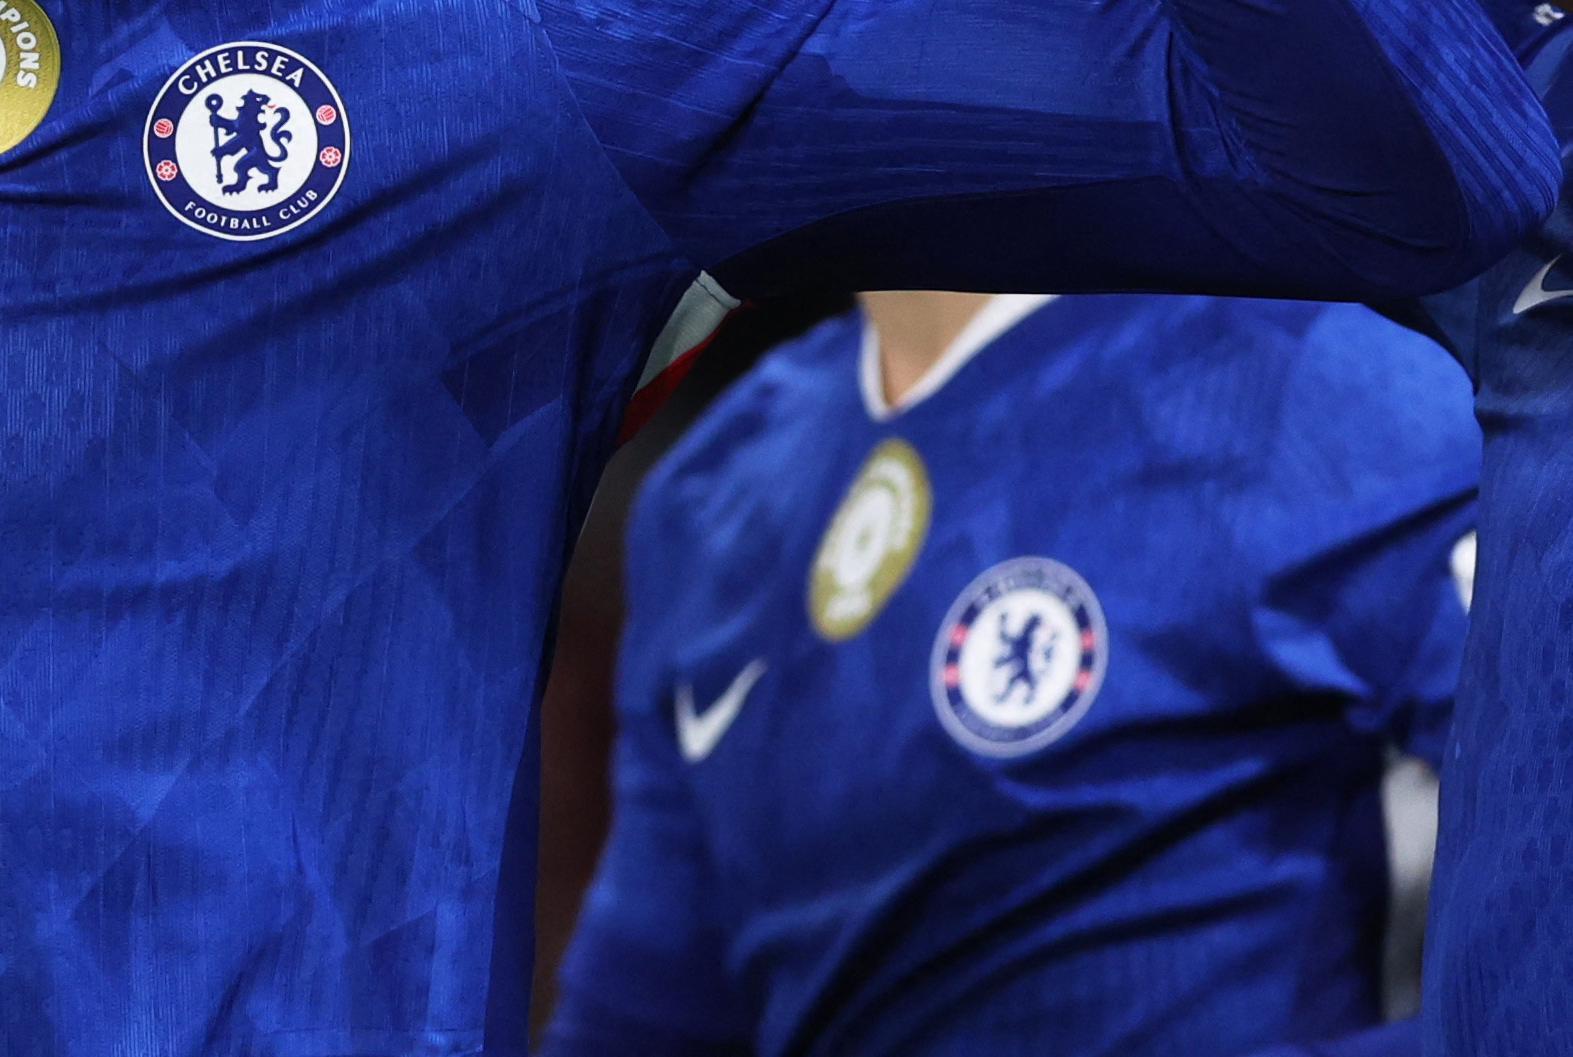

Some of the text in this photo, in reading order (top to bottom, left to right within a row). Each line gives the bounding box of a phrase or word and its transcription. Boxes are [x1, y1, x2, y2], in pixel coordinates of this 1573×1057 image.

[178, 50, 304, 95] CHELSEA
[184, 189, 318, 230] FOOTBALL CLUB
